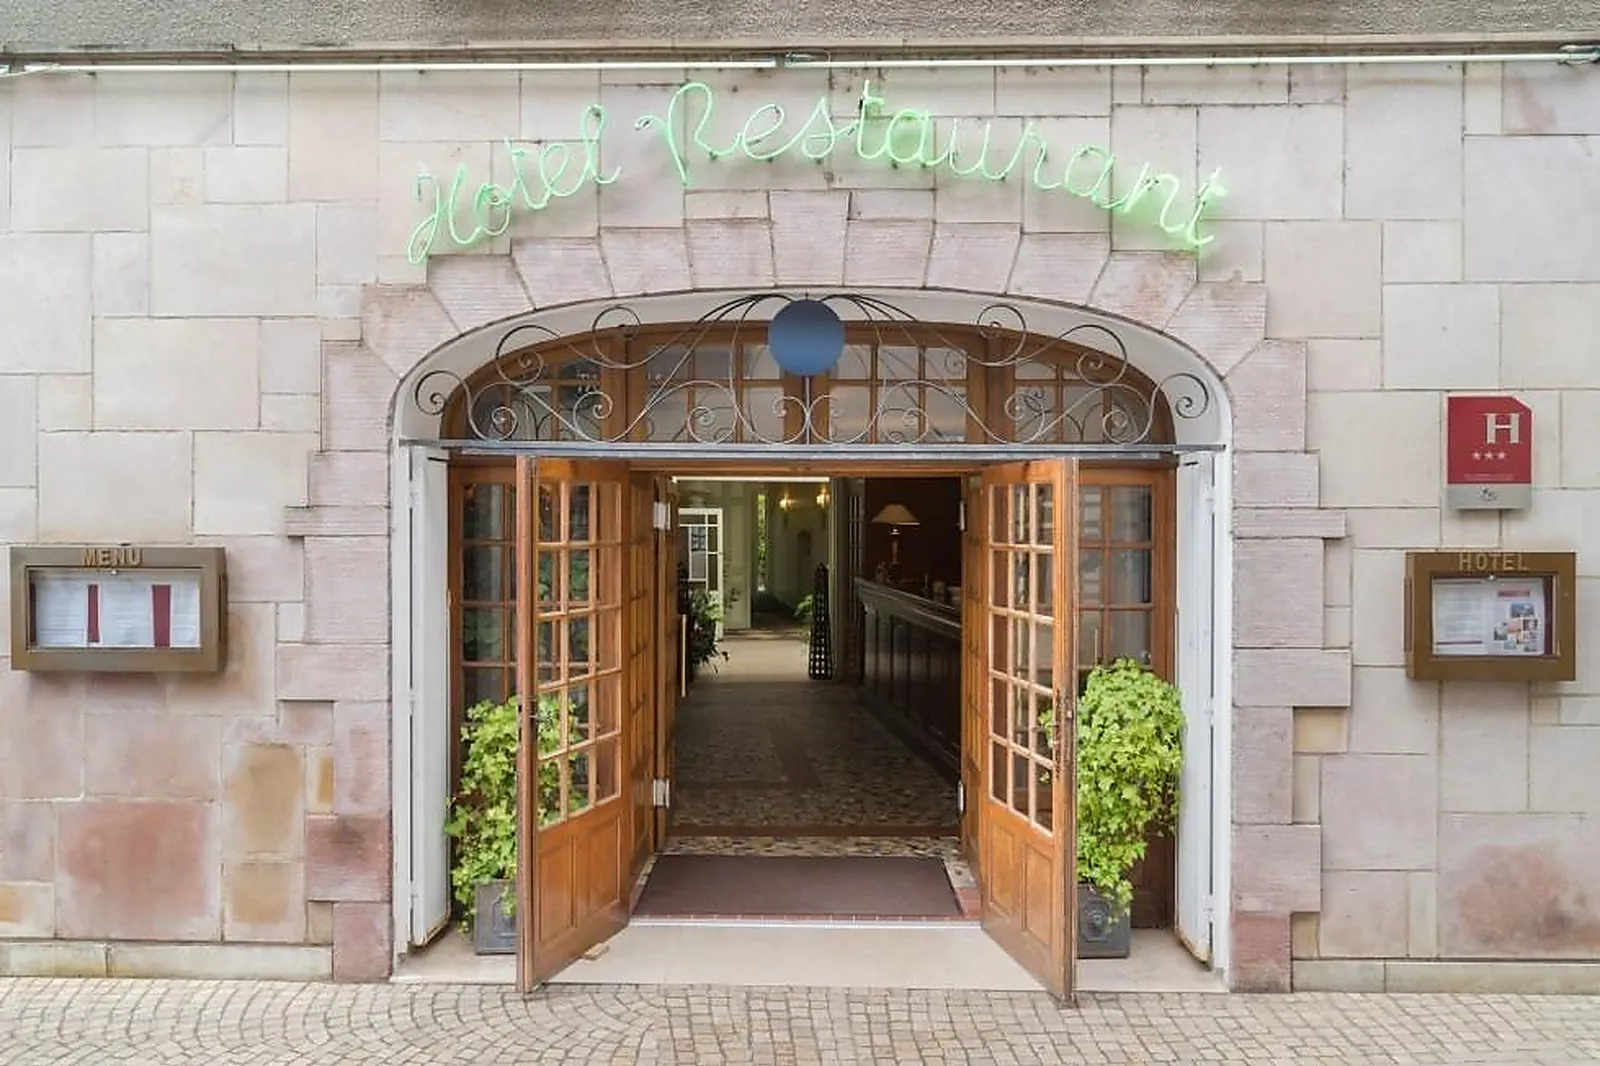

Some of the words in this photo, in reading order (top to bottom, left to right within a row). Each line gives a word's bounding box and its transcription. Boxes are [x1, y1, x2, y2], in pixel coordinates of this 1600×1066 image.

[406, 103, 624, 265] Hotel
[635, 80, 1227, 247] Restaurant
[1483, 412, 1521, 444] H
[82, 548, 144, 566] MENU
[1457, 552, 1529, 572] HOTEL
